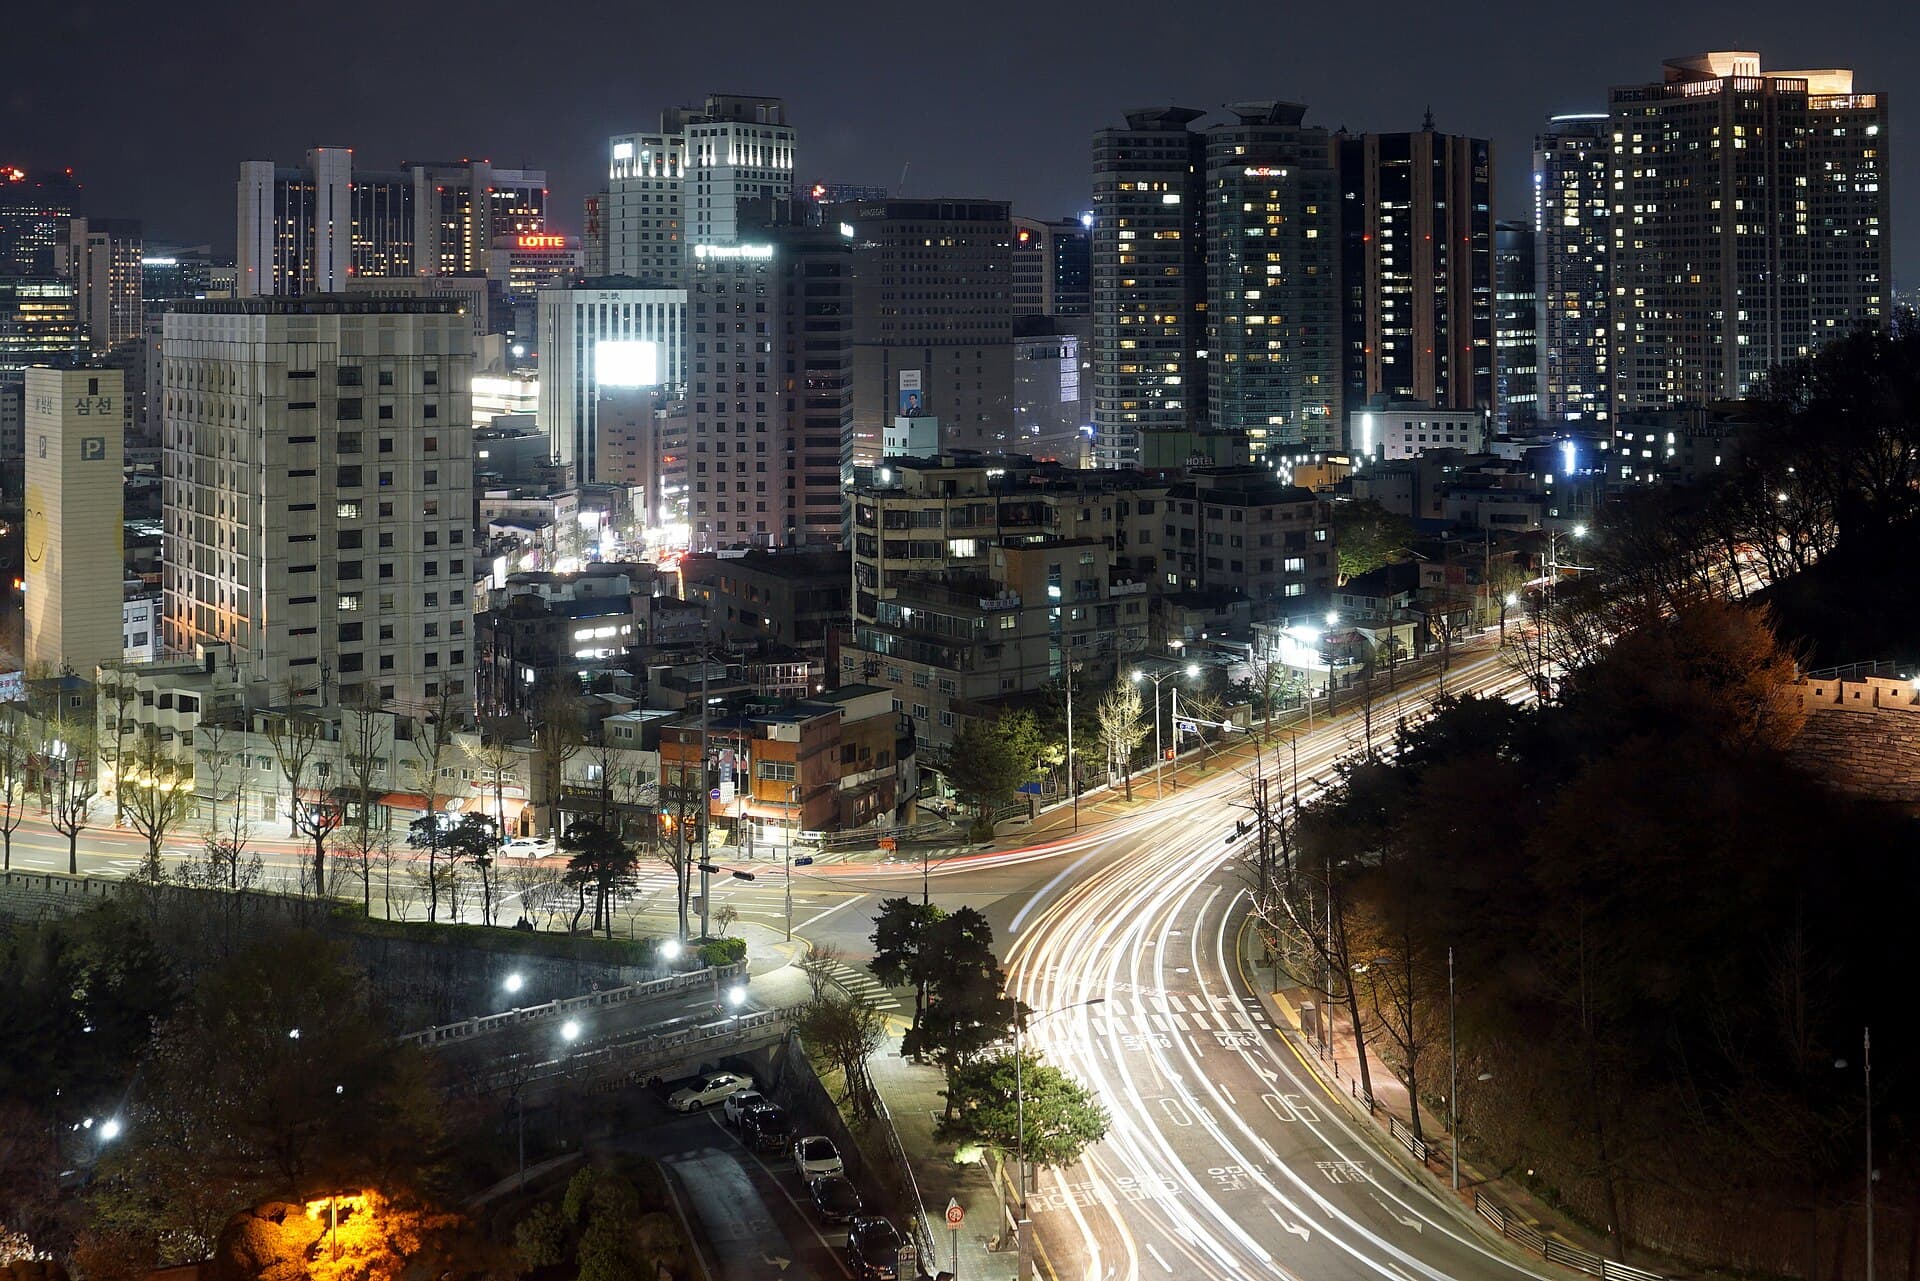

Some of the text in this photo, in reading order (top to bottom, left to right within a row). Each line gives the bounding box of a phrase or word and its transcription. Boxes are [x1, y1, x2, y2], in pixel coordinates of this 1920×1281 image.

[518, 236, 565, 247] LOTTE
[74, 397, 112, 415] 삼선
[86, 439, 101, 459] P
[1186, 457, 1214, 465] HOTEL
[1261, 1094, 1321, 1122] 50
